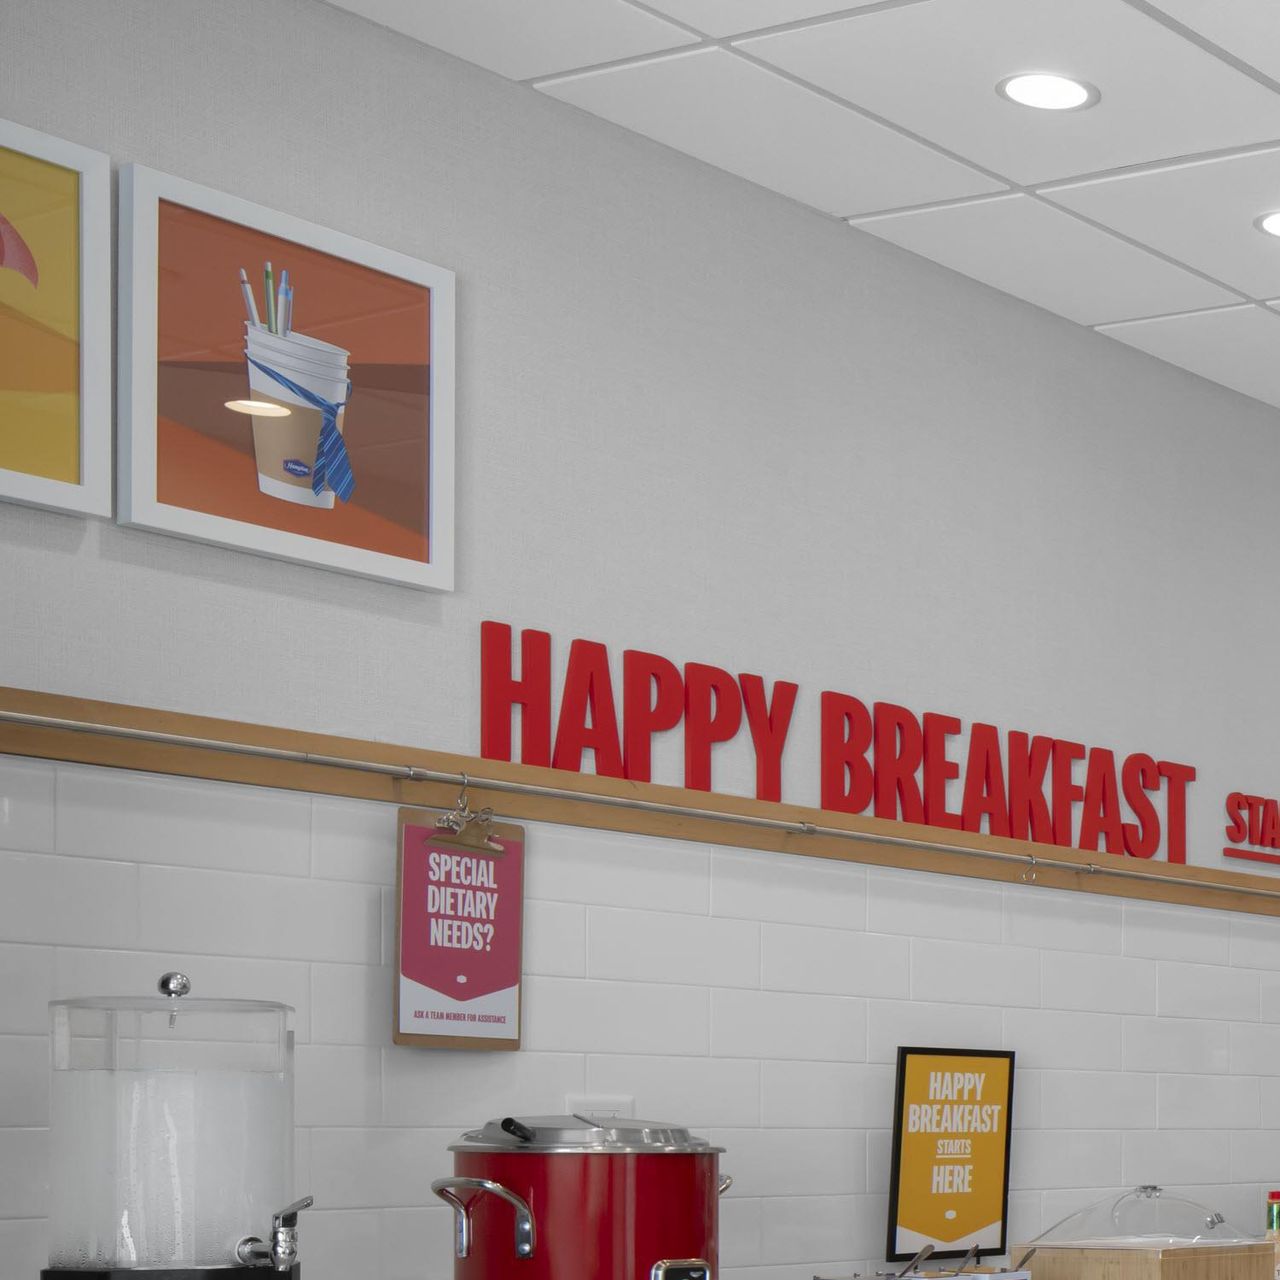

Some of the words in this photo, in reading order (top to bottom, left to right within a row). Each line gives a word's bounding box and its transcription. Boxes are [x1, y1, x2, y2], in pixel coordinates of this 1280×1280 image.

[480, 620, 799, 804] HAPPY
[820, 690, 1197, 866] BREAKFAST
[428, 852, 498, 889] SPECIAL
[427, 884, 499, 920] DIETARY
[429, 917, 495, 952] NEEDS?
[928, 1071, 986, 1100] HAPPY
[908, 1104, 1001, 1133] BREAKFAST
[936, 1139, 971, 1154] STARTS
[931, 1165, 973, 1193] HERE
